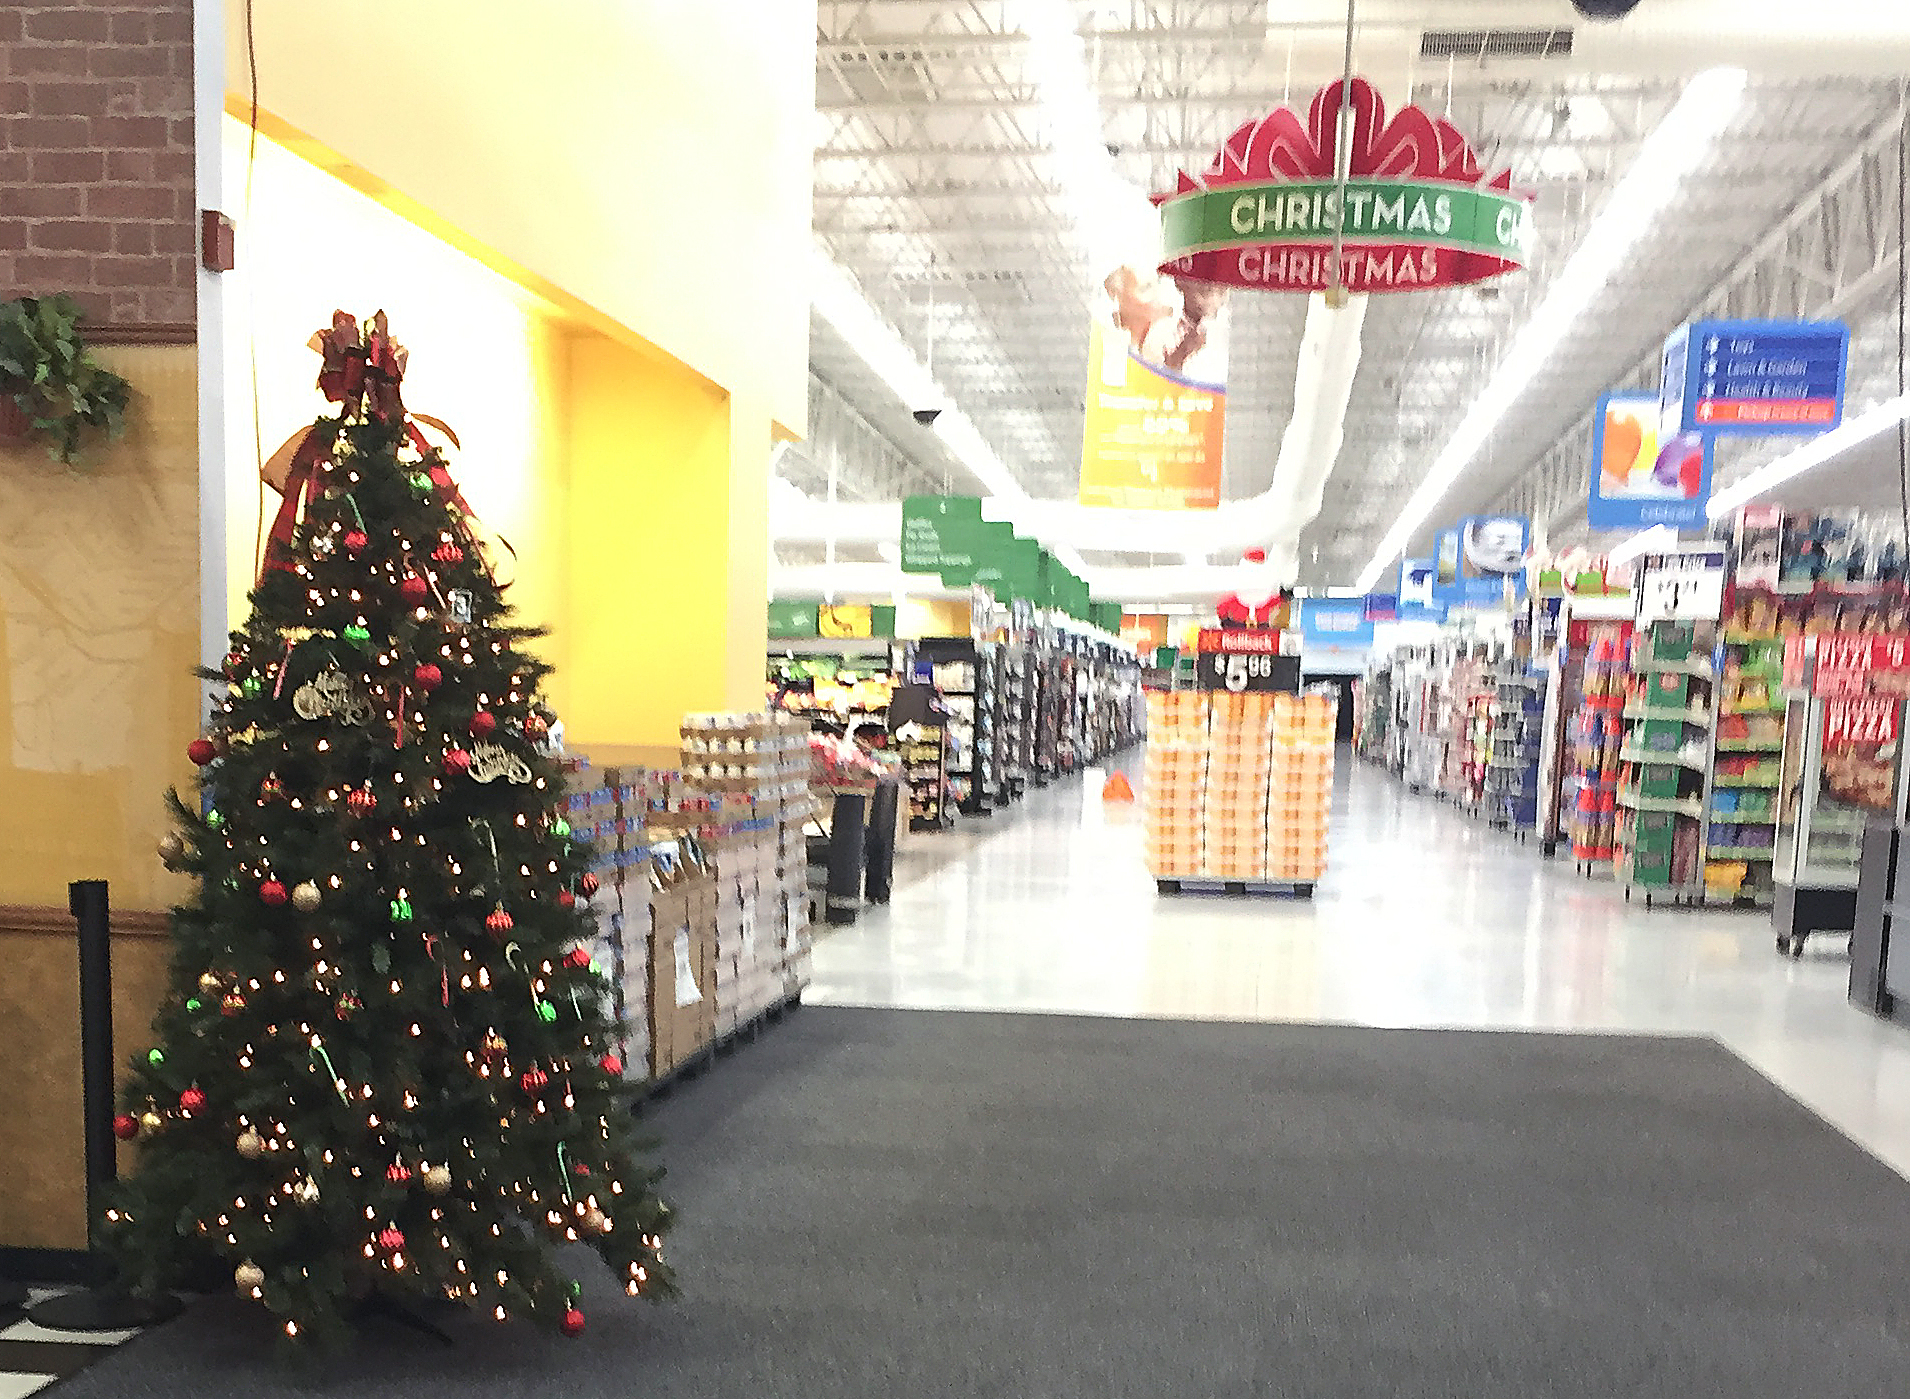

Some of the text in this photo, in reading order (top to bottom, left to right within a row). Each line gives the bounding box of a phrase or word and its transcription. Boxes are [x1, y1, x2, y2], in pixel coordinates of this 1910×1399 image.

[1230, 189, 1452, 235] CHRISTMAS
[1238, 248, 1438, 286] CHRISTMAS
[1827, 697, 1895, 741] PIZZA
